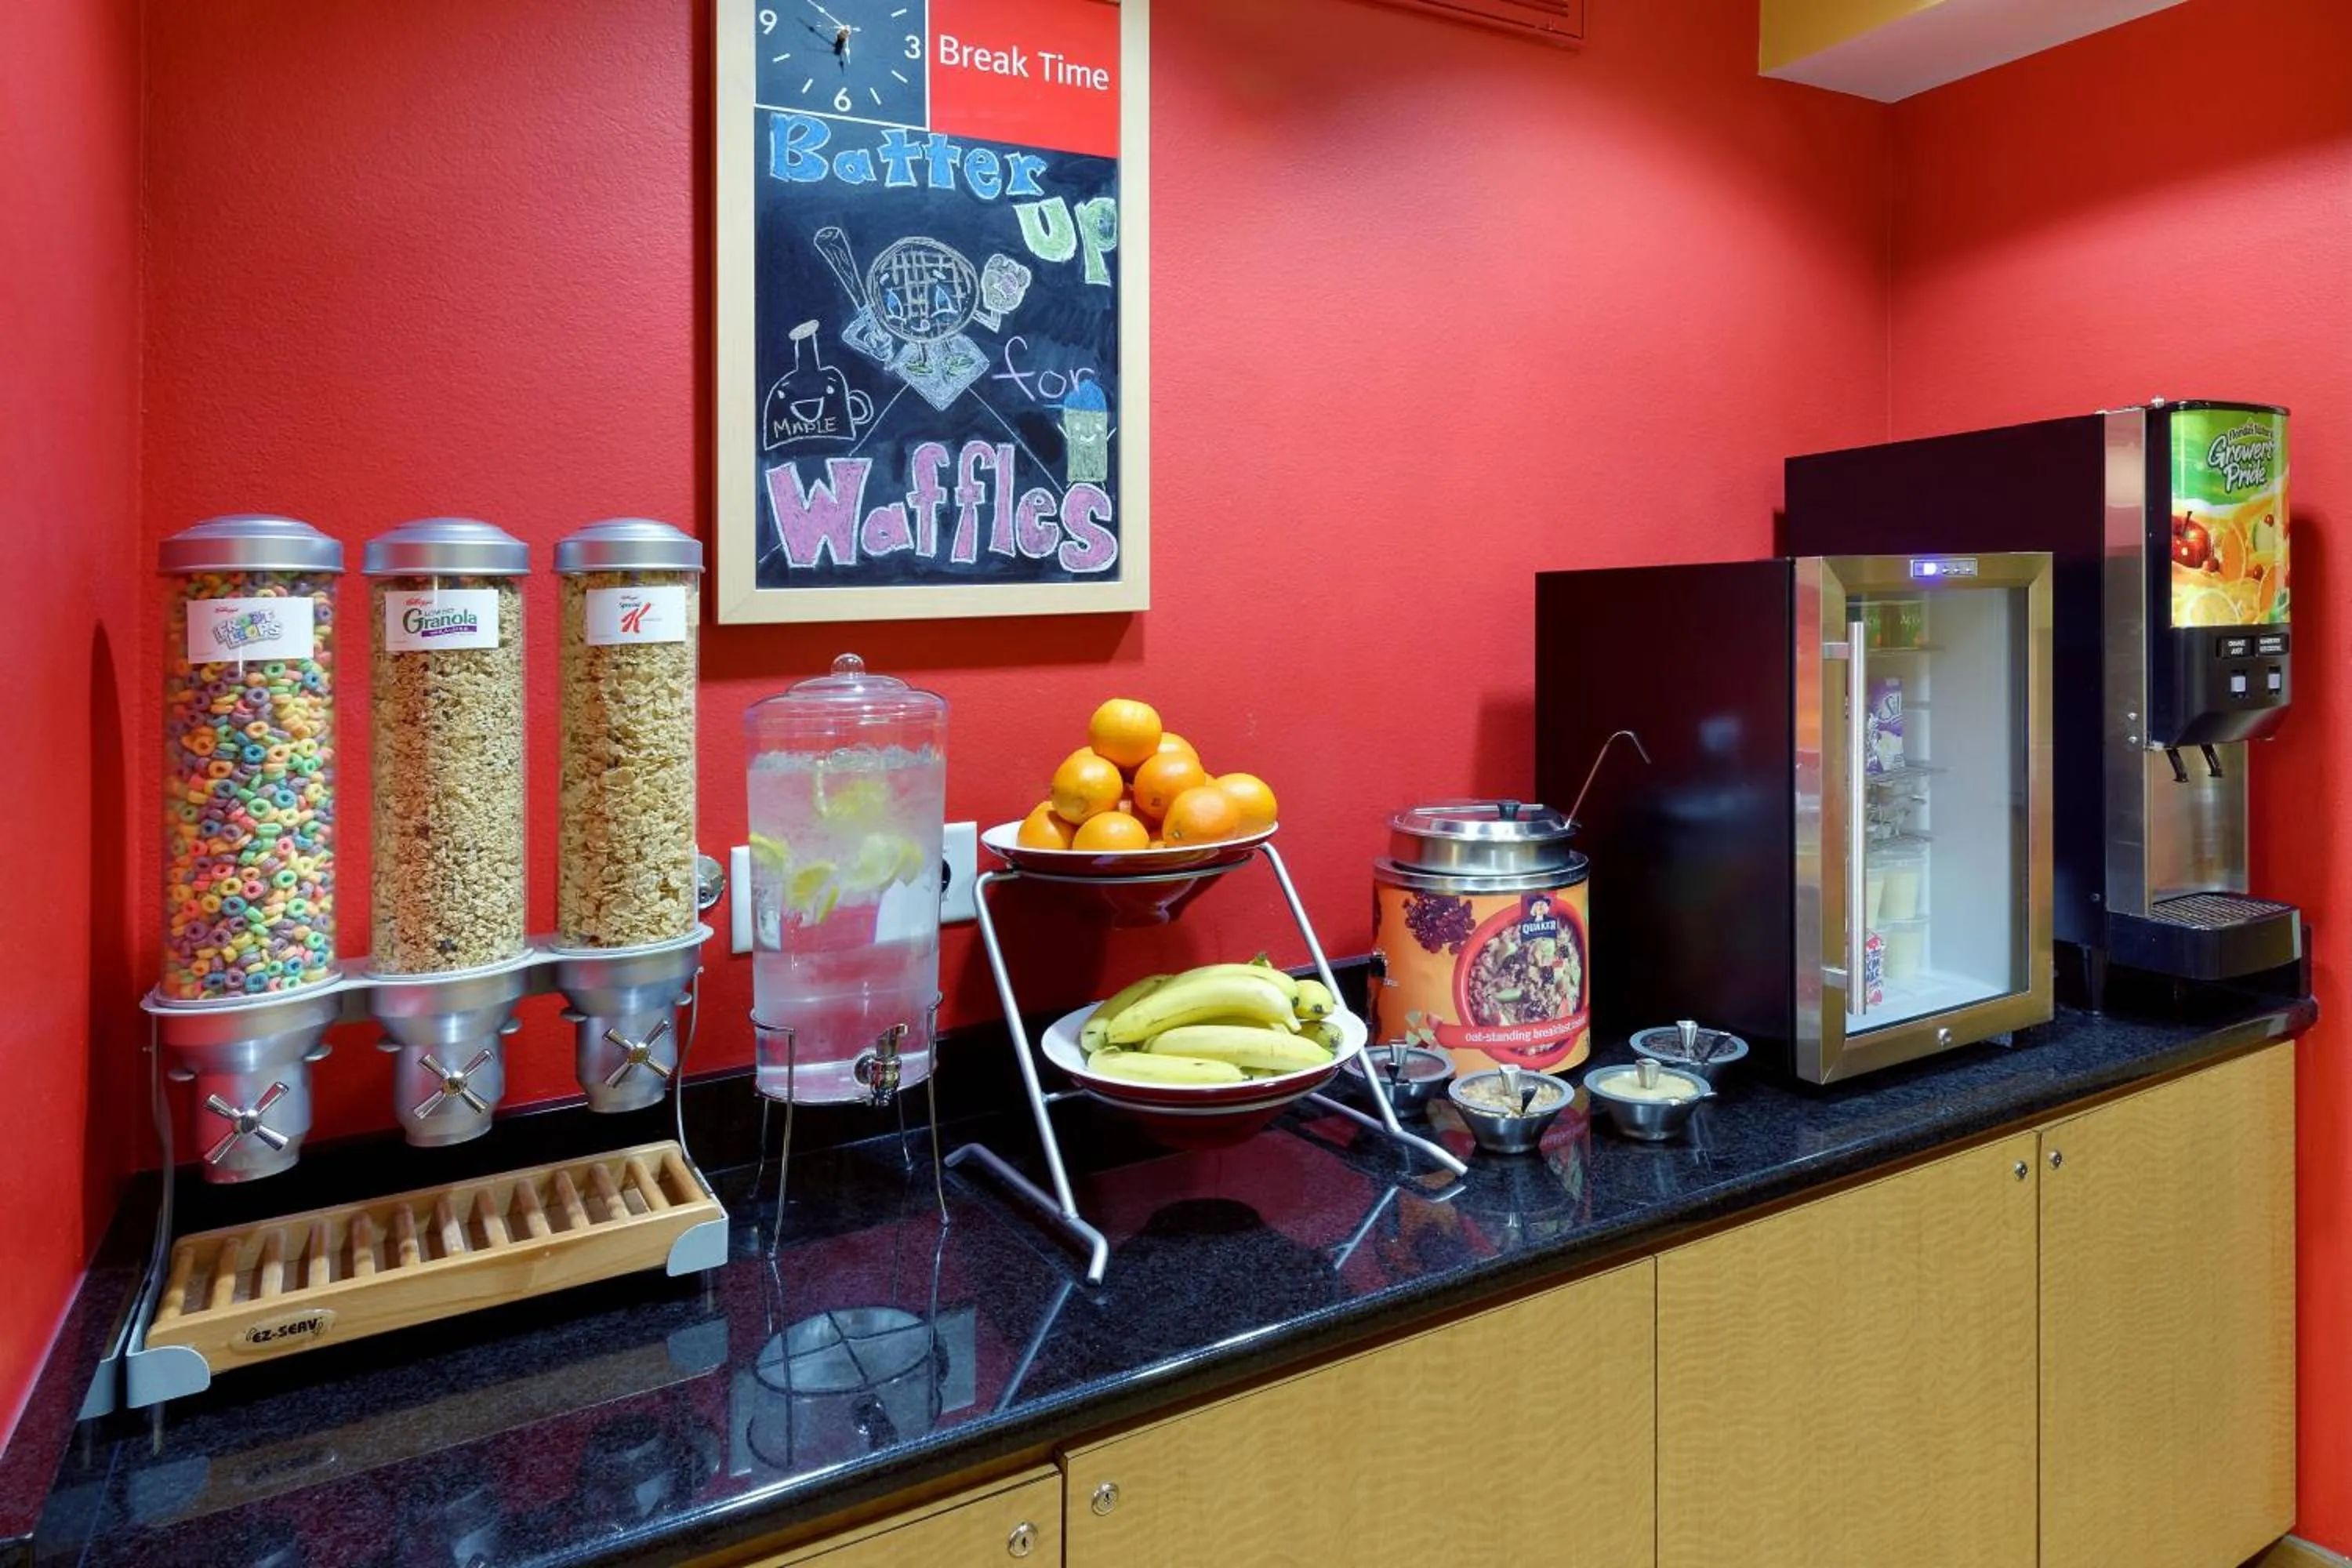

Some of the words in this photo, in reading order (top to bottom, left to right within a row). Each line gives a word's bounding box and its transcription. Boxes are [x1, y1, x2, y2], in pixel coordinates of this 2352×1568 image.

[759, 9, 778, 35] 9
[904, 35, 921, 60] 3
[939, 34, 1029, 78] Break
[1038, 52, 1110, 91] Time
[833, 87, 852, 112] 6
[769, 112, 1048, 201] Batter
[992, 336, 1094, 402] for
[773, 416, 837, 439] MAPLE
[2223, 459, 2266, 492] Pride
[765, 441, 1119, 573] Waffles
[402, 608, 477, 634] Granola
[1522, 920, 1556, 935] QUAKER
